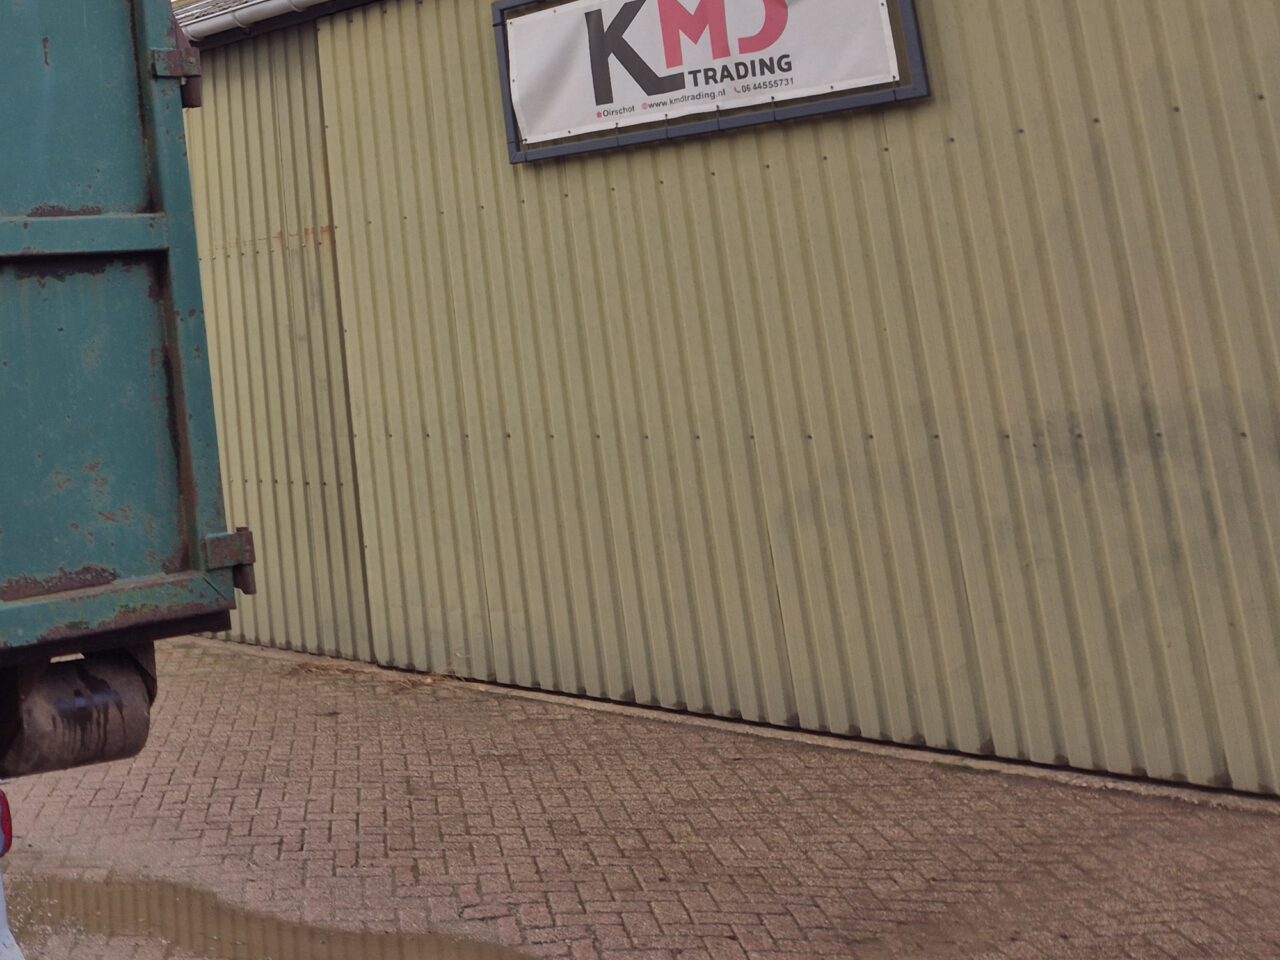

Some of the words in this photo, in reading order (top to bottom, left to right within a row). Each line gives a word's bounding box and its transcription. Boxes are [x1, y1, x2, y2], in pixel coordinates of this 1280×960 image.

[688, 54, 792, 87] TRADING
[603, 105, 635, 117] Oirschot
[648, 89, 726, 109] www.kmdtrading.nl
